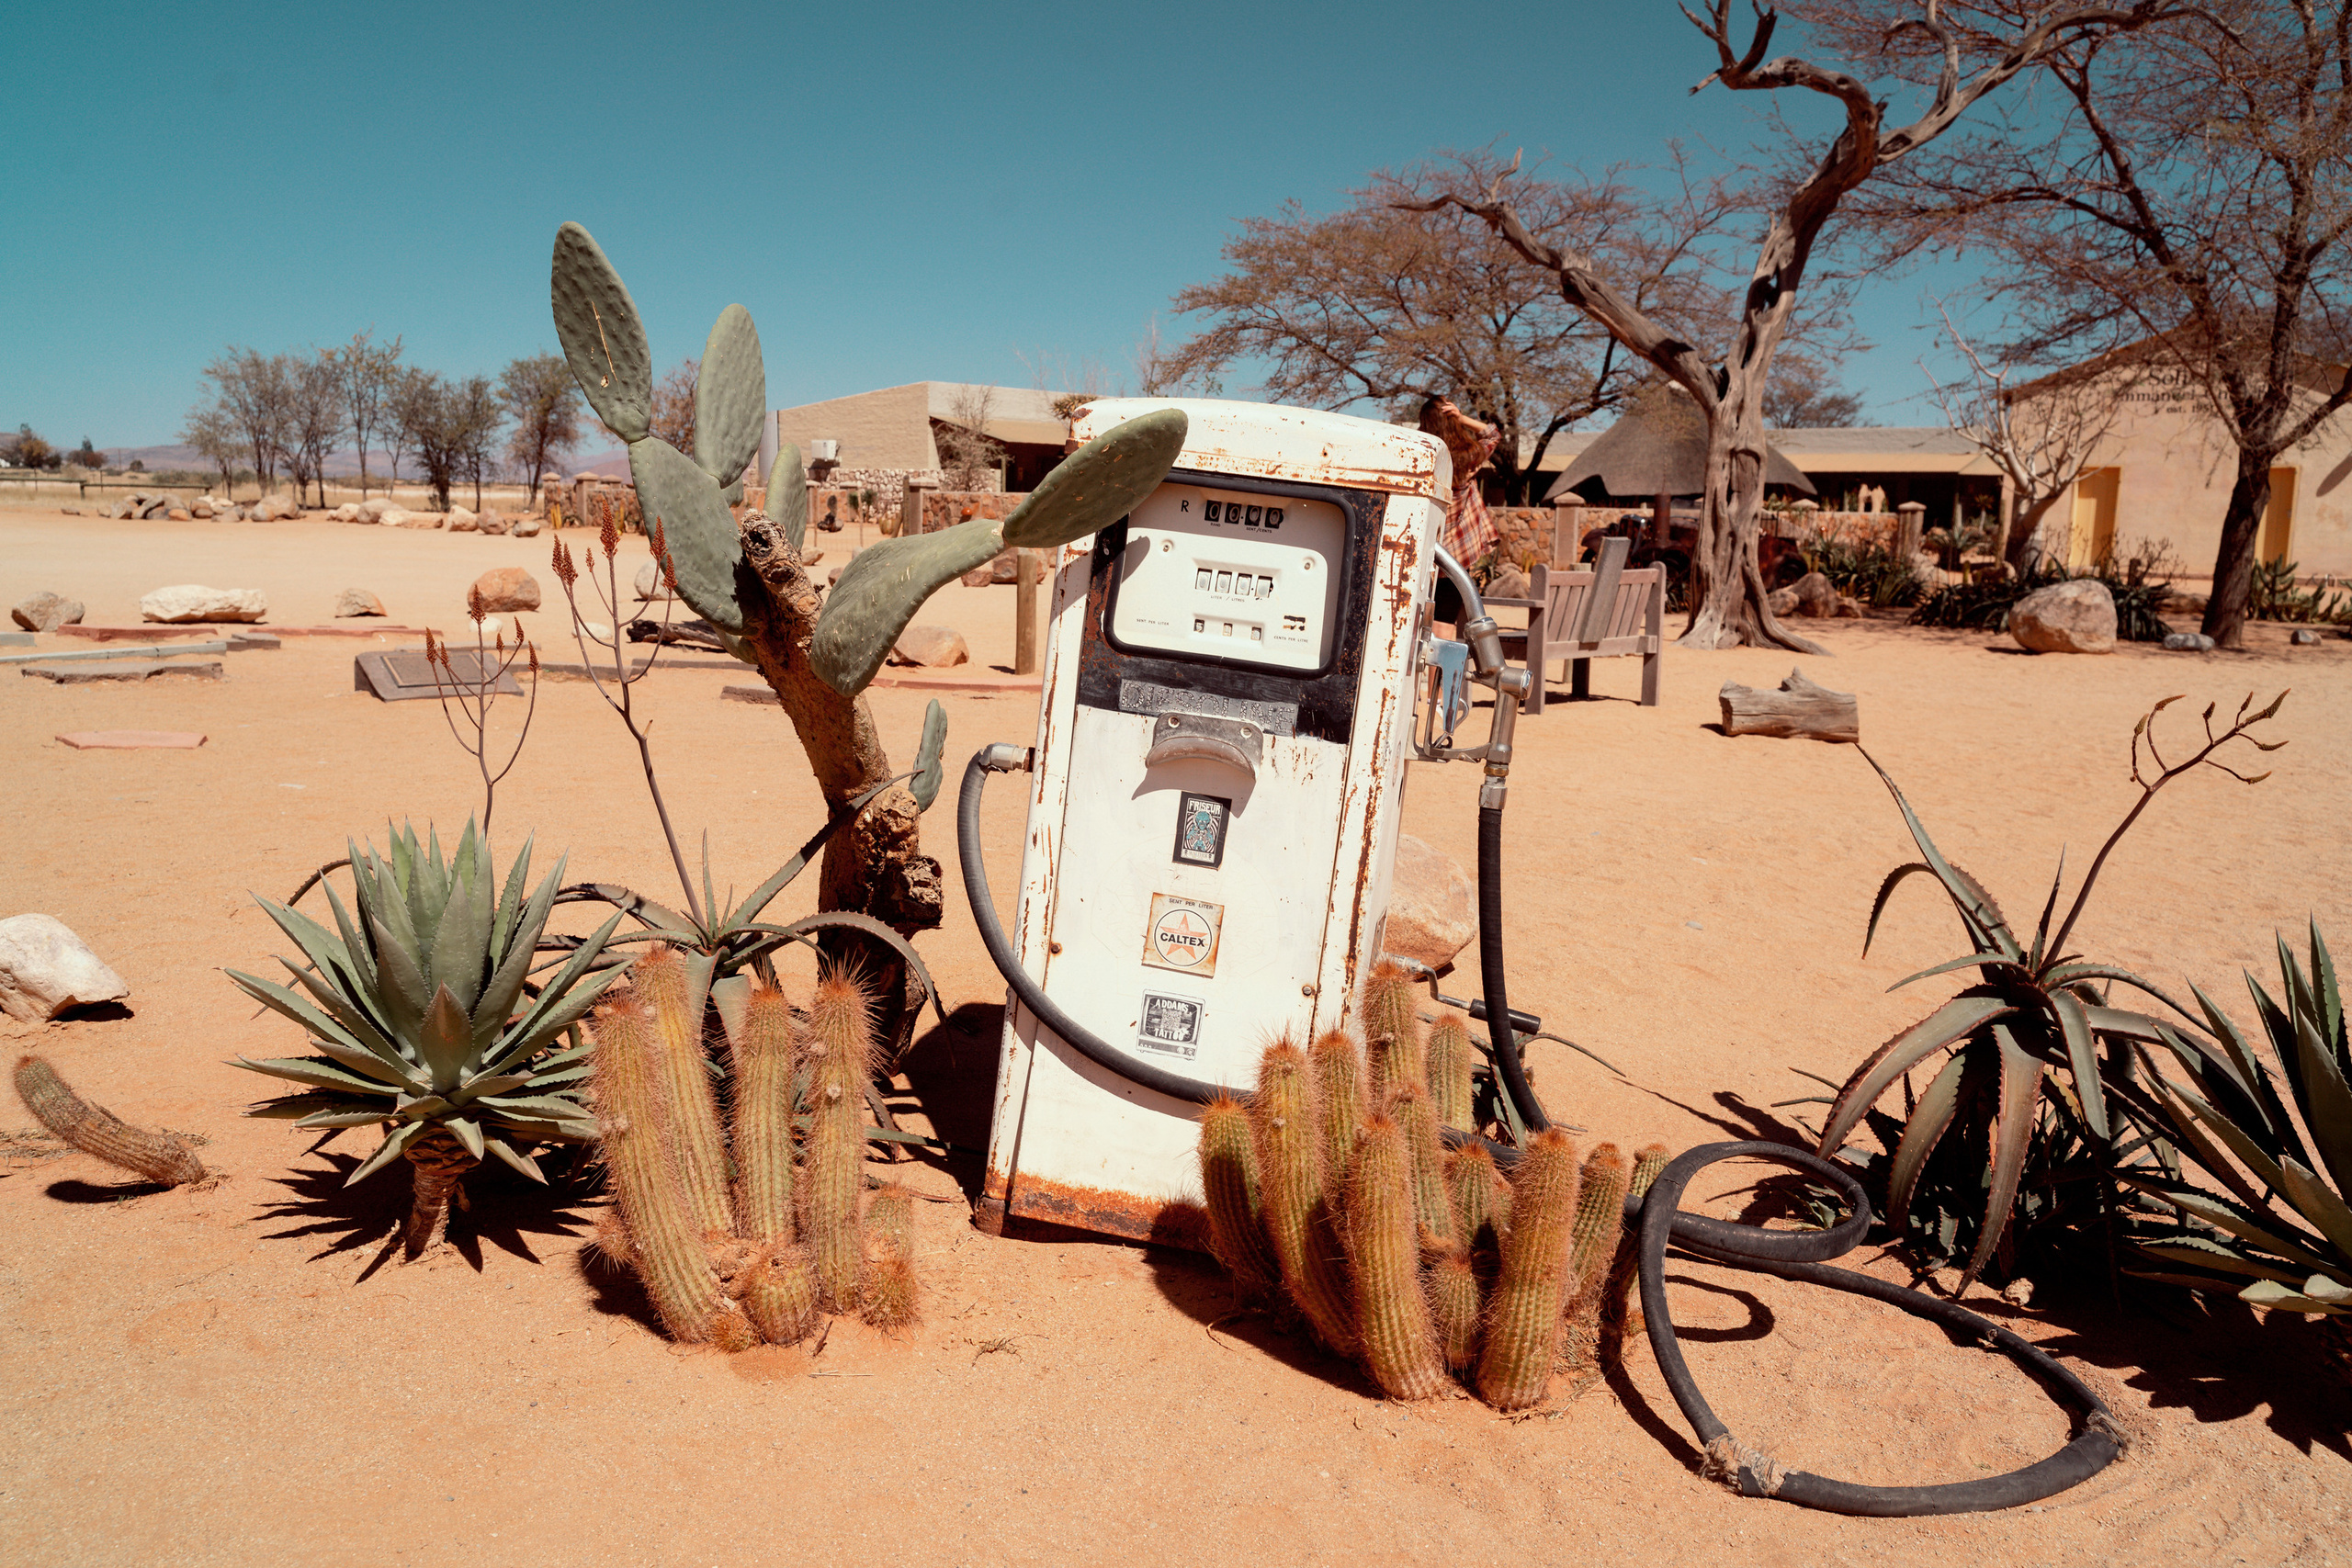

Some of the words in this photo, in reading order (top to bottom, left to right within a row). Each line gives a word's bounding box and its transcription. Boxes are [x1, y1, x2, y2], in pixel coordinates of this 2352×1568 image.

[1181, 500, 1190, 513] R
[1189, 800, 1221, 815] FRISEUR
[1160, 932, 1205, 947] CALTEX
[1155, 998, 1189, 1012] ADDAMS
[1154, 1028, 1185, 1041] TATTOO
